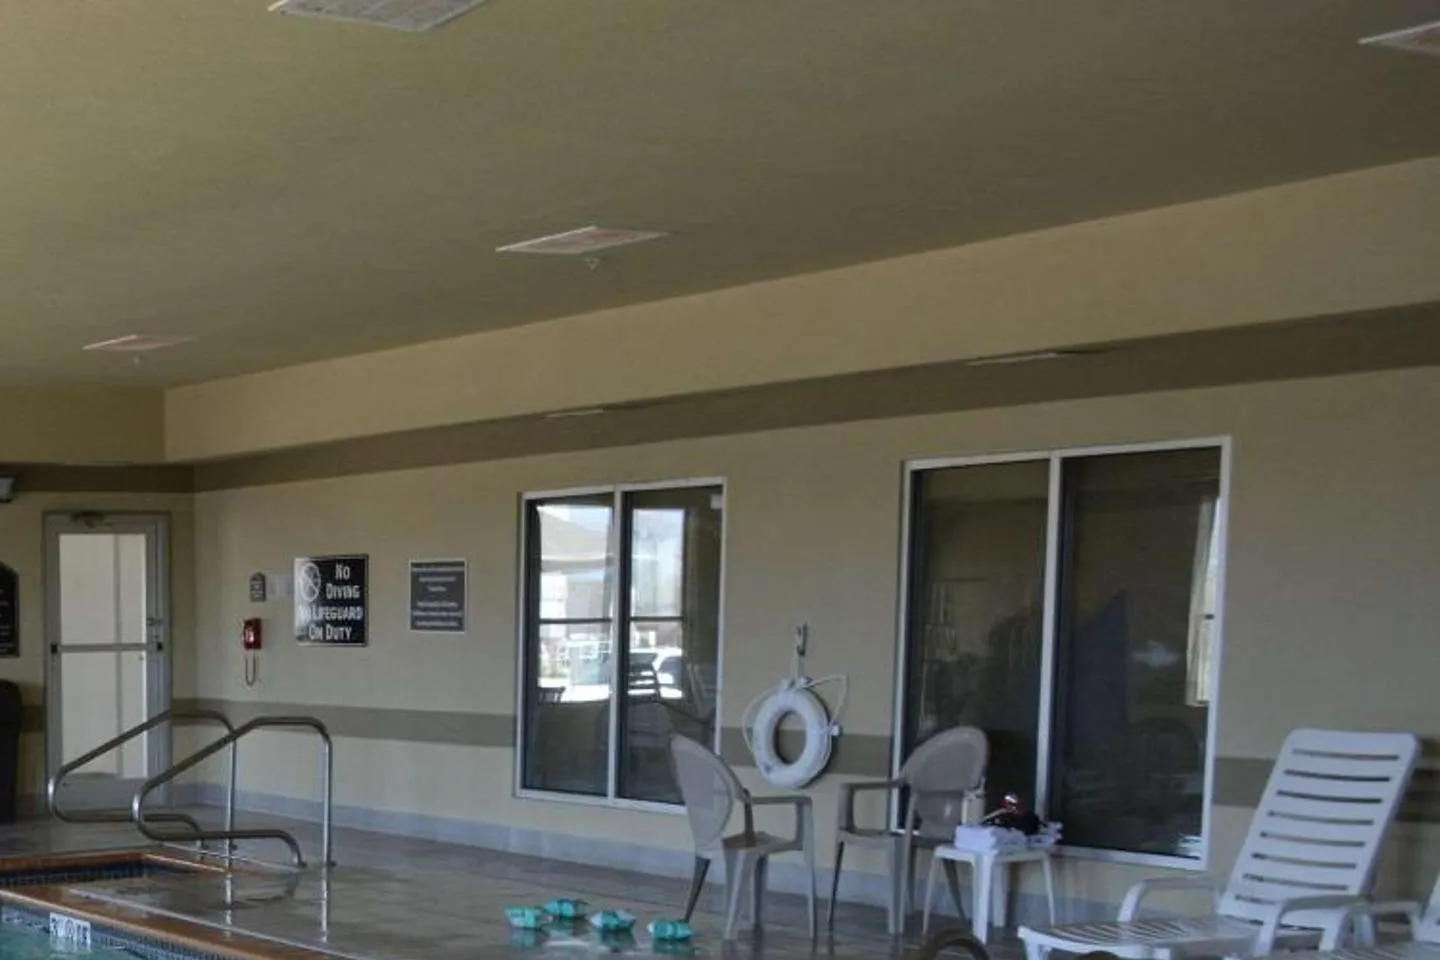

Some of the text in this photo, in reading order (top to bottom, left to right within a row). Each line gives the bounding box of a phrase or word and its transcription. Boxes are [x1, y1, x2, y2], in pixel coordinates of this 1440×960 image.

[326, 583, 360, 599] DIVING
[313, 605, 364, 621] LIFEGUARD
[309, 623, 352, 640] ON DUTY
